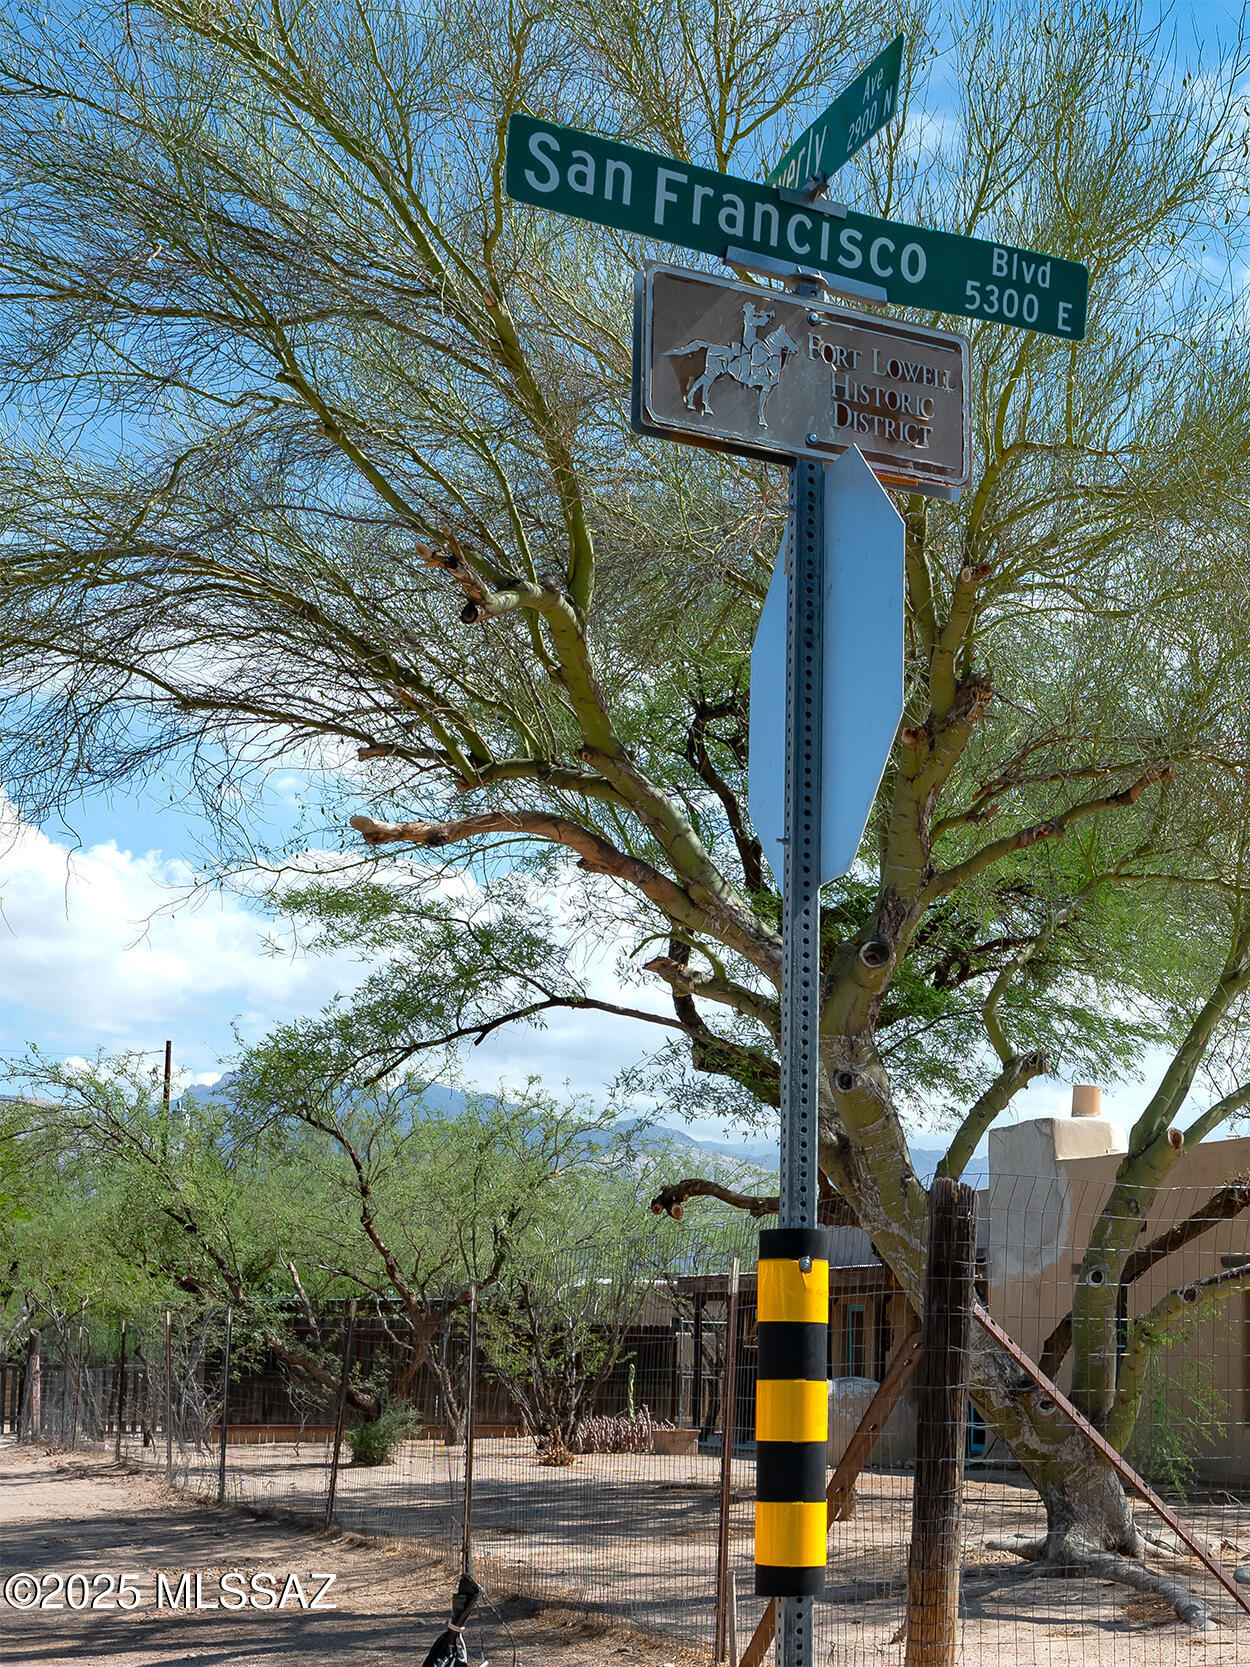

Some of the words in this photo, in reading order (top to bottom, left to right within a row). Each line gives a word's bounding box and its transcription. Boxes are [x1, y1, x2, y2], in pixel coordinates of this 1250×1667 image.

[862, 67, 885, 105] Ave
[846, 101, 877, 153] 2900
[883, 84, 893, 117] N
[523, 132, 632, 204] San
[652, 166, 927, 283] Francisco
[991, 246, 1051, 288] Blvd
[964, 281, 1039, 323] 5300
[1057, 302, 1073, 332] E
[807, 332, 862, 370] FORT
[871, 348, 955, 393] LOWELL
[831, 371, 935, 419] HISTORIC
[832, 400, 934, 448] DISTRICT
